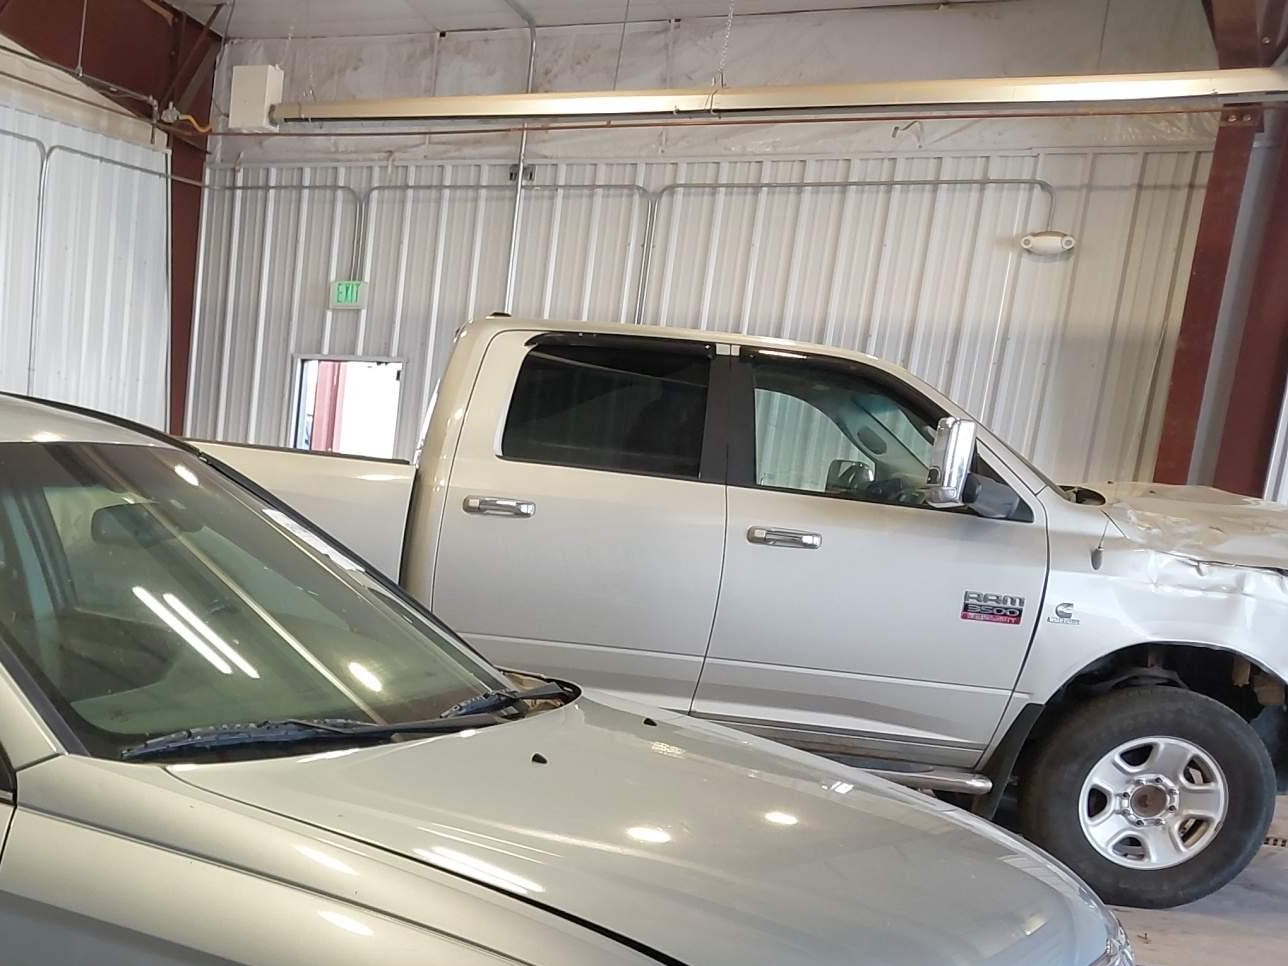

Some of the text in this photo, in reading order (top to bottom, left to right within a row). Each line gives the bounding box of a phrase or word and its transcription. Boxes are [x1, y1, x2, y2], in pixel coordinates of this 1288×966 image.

[336, 282, 361, 304] EXIT
[963, 590, 1024, 607] RAM
[966, 604, 1020, 617] 3500
